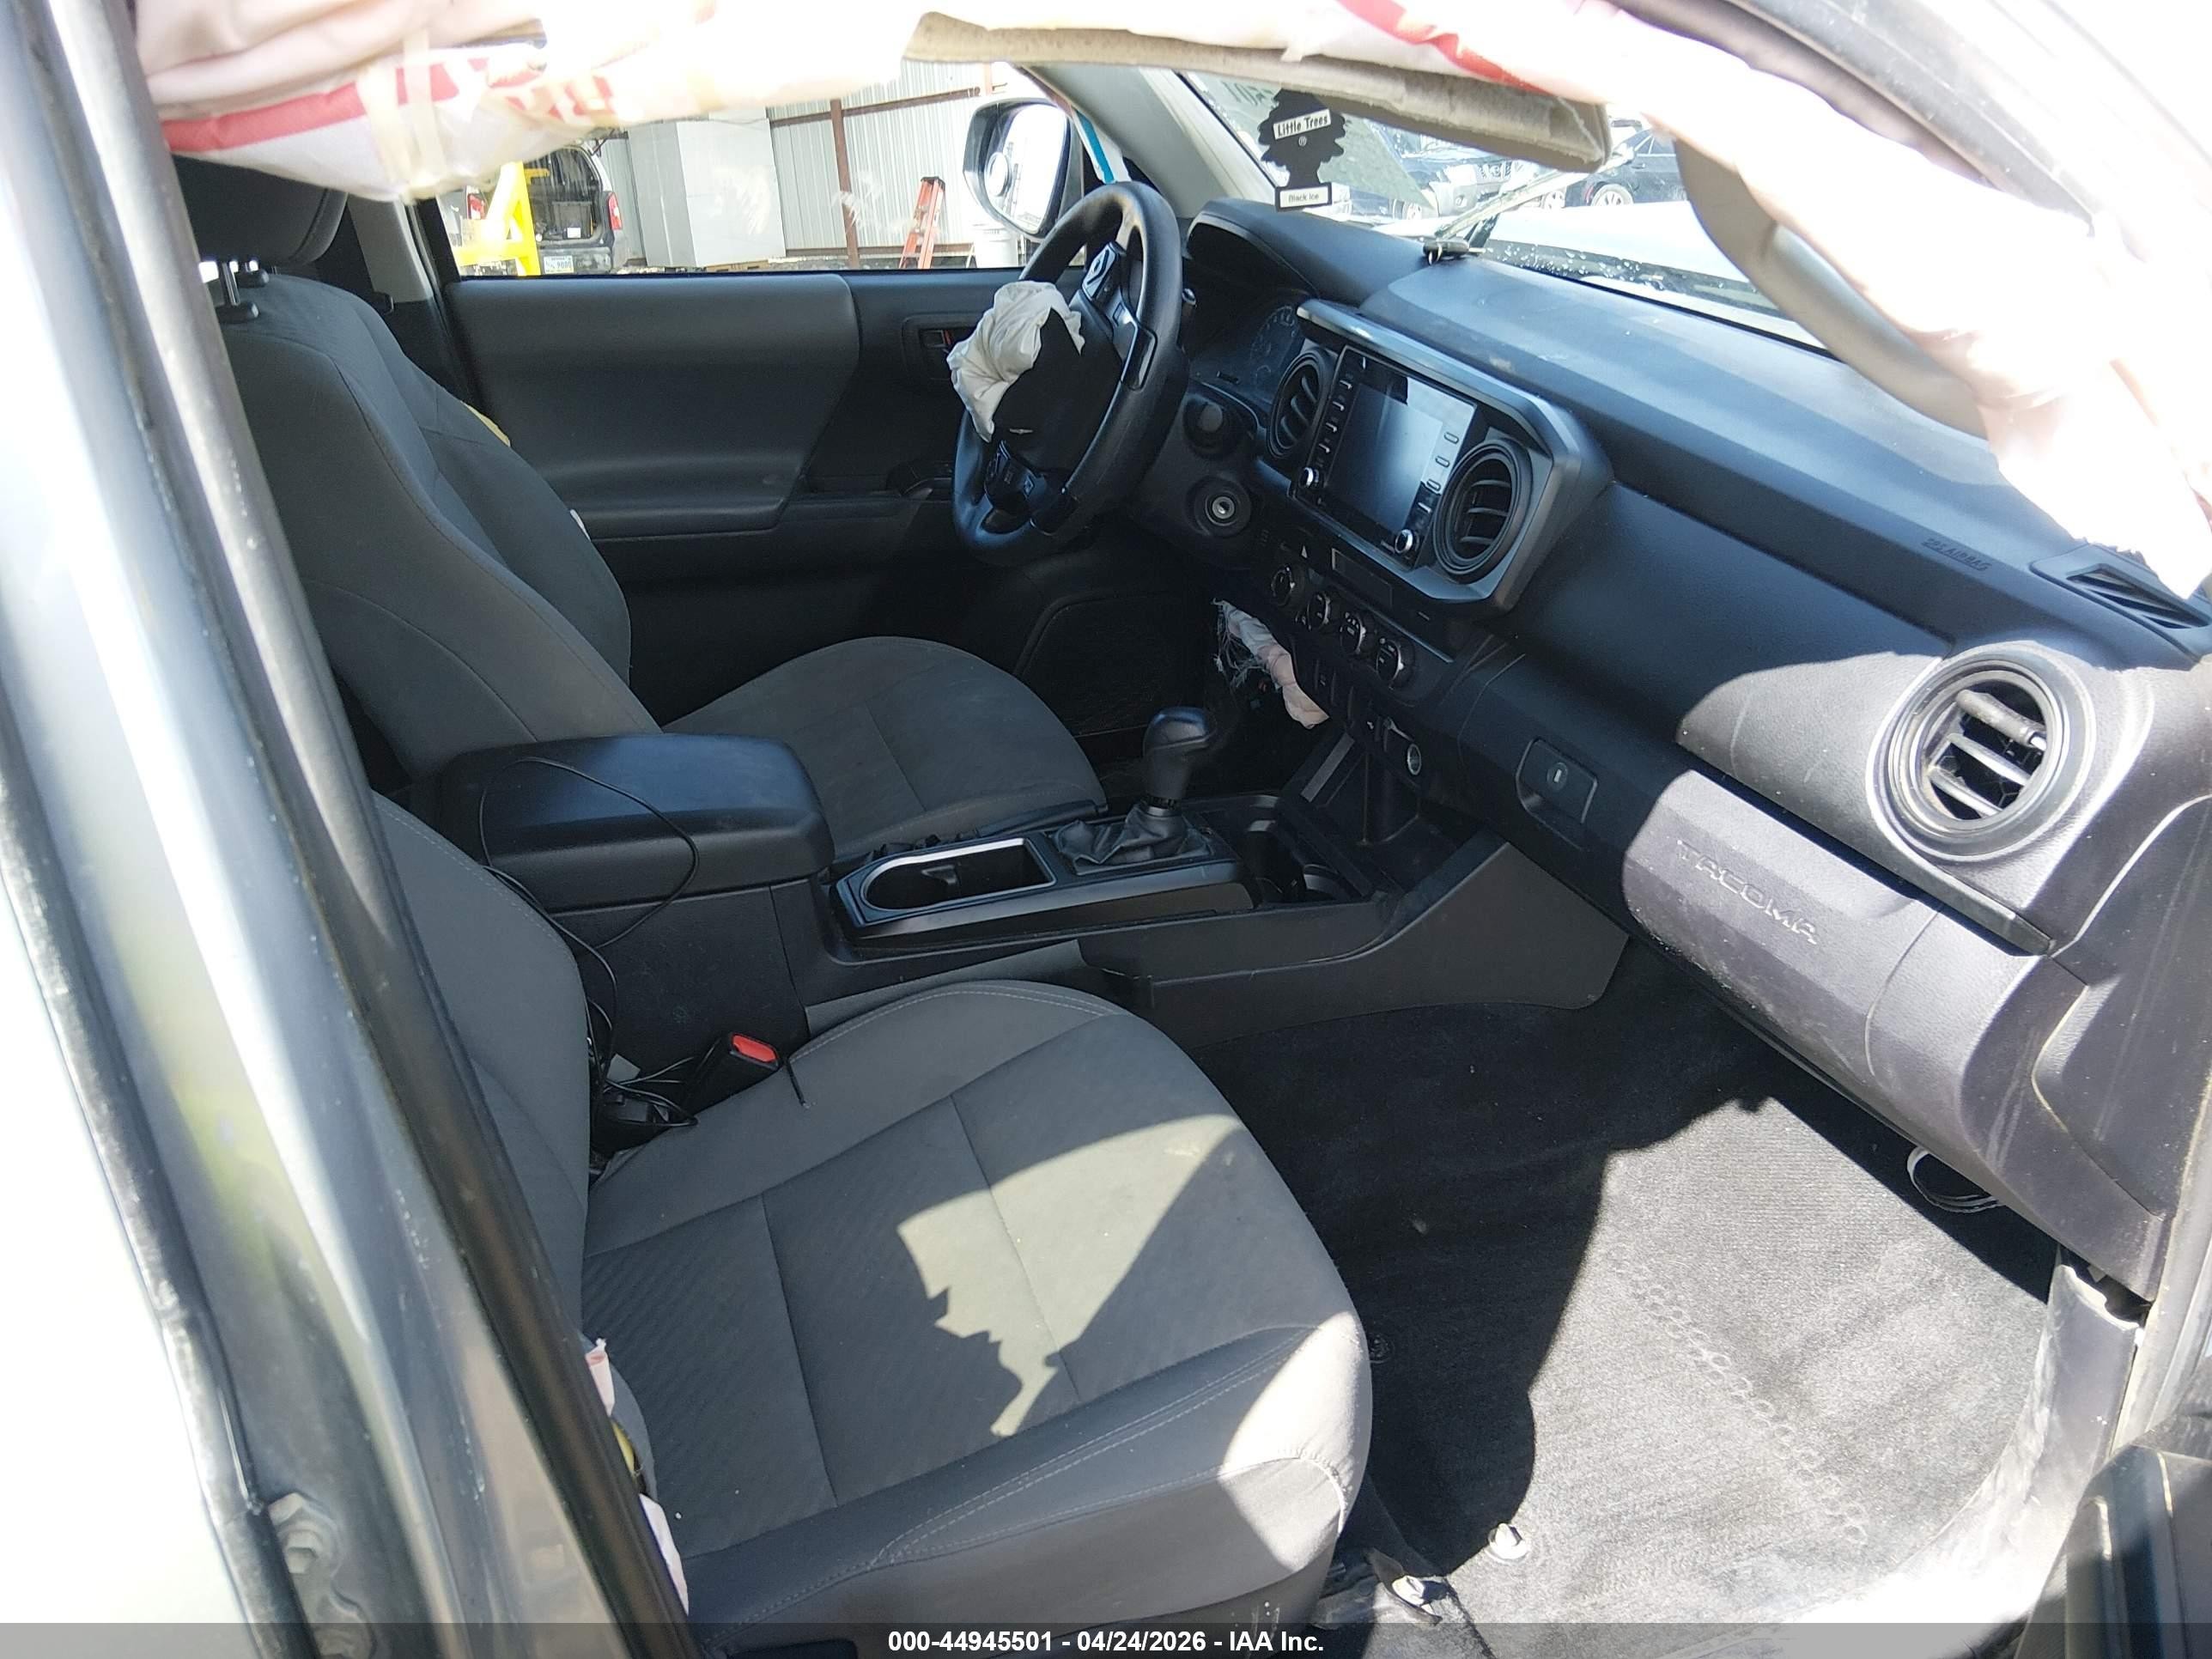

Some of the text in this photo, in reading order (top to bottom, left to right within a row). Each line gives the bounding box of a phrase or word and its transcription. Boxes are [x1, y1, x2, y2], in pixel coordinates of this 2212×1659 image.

[1277, 114, 1328, 137] Little Trees
[1288, 193, 1307, 203] Black
[1676, 839, 1818, 945] TACOMA
